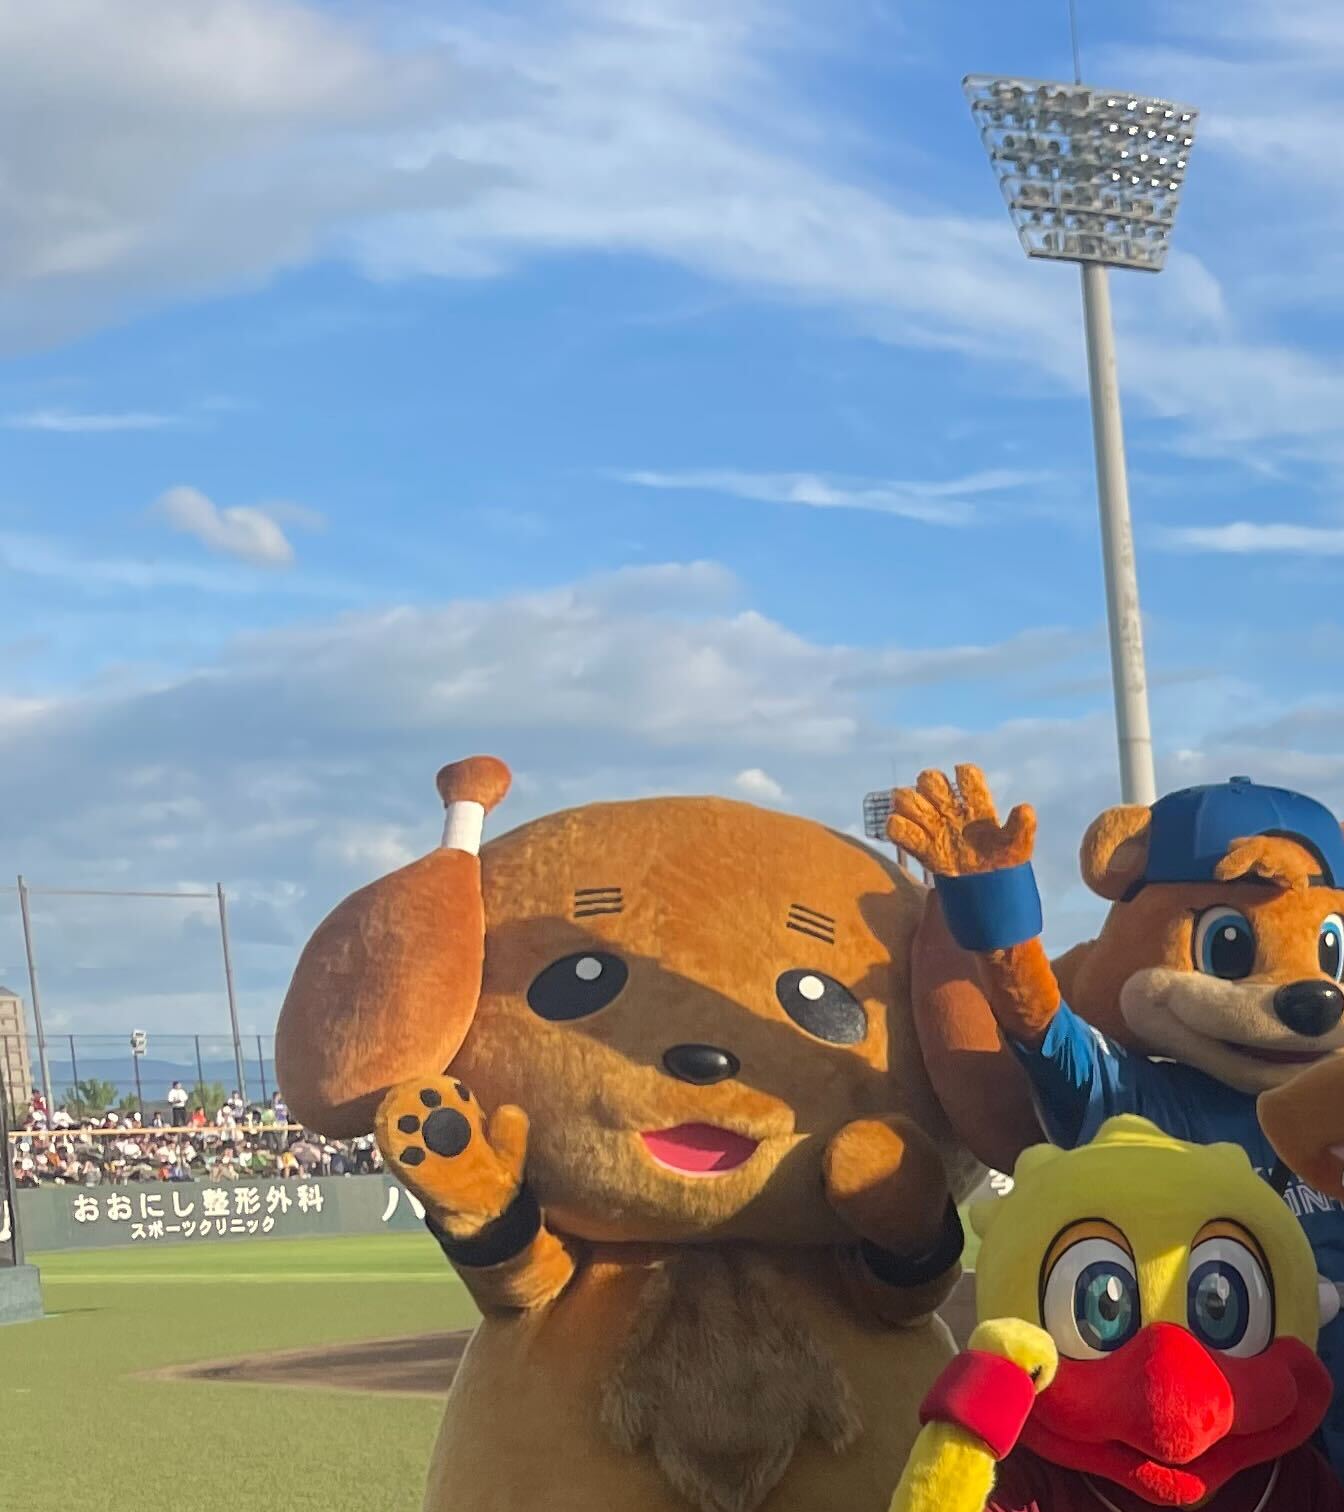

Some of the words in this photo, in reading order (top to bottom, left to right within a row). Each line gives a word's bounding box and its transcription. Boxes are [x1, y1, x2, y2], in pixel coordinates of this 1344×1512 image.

[72, 1183, 325, 1223] おおにし整形外科
[130, 1216, 276, 1240] スポーツクリニック
